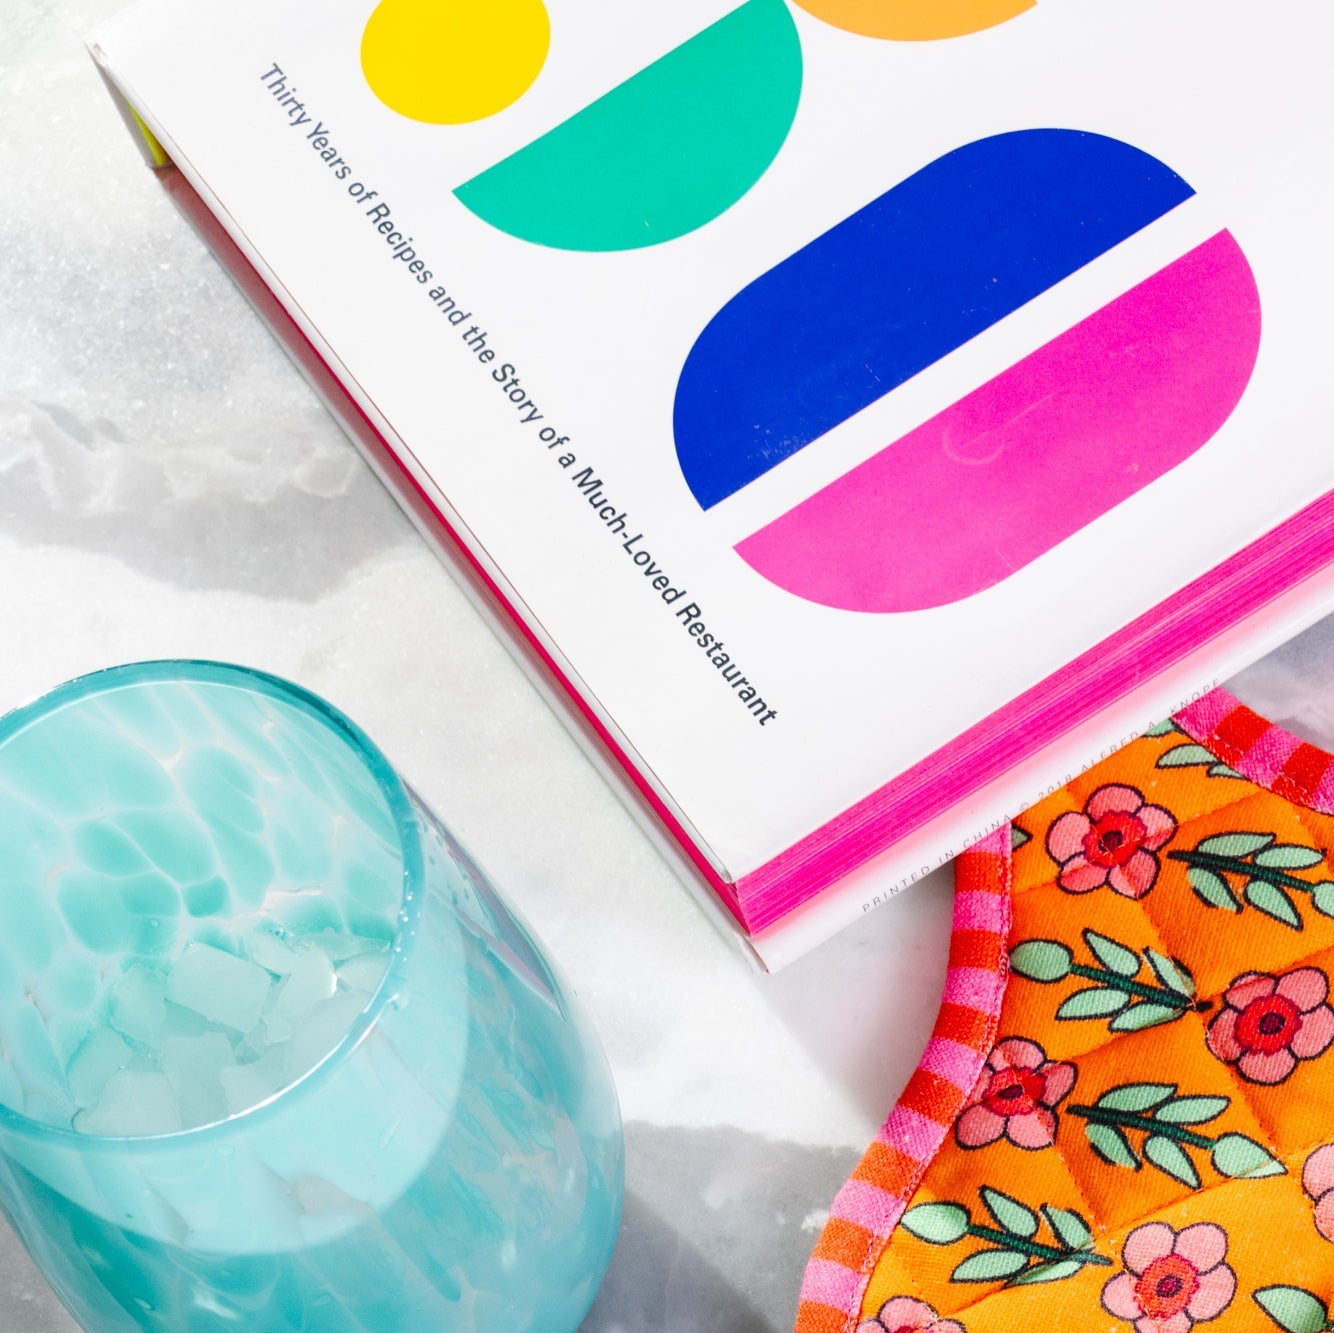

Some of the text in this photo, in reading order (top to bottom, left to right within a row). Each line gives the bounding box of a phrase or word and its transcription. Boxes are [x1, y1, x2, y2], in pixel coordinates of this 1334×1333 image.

[259, 62, 779, 728] Thirty Years of Recipes and the Story of a Much-Loved Restaurant
[862, 865, 930, 912] PRINTED
[939, 849, 954, 864] IN
[963, 814, 1011, 848] CHINA
[1037, 774, 1072, 800] 2018
